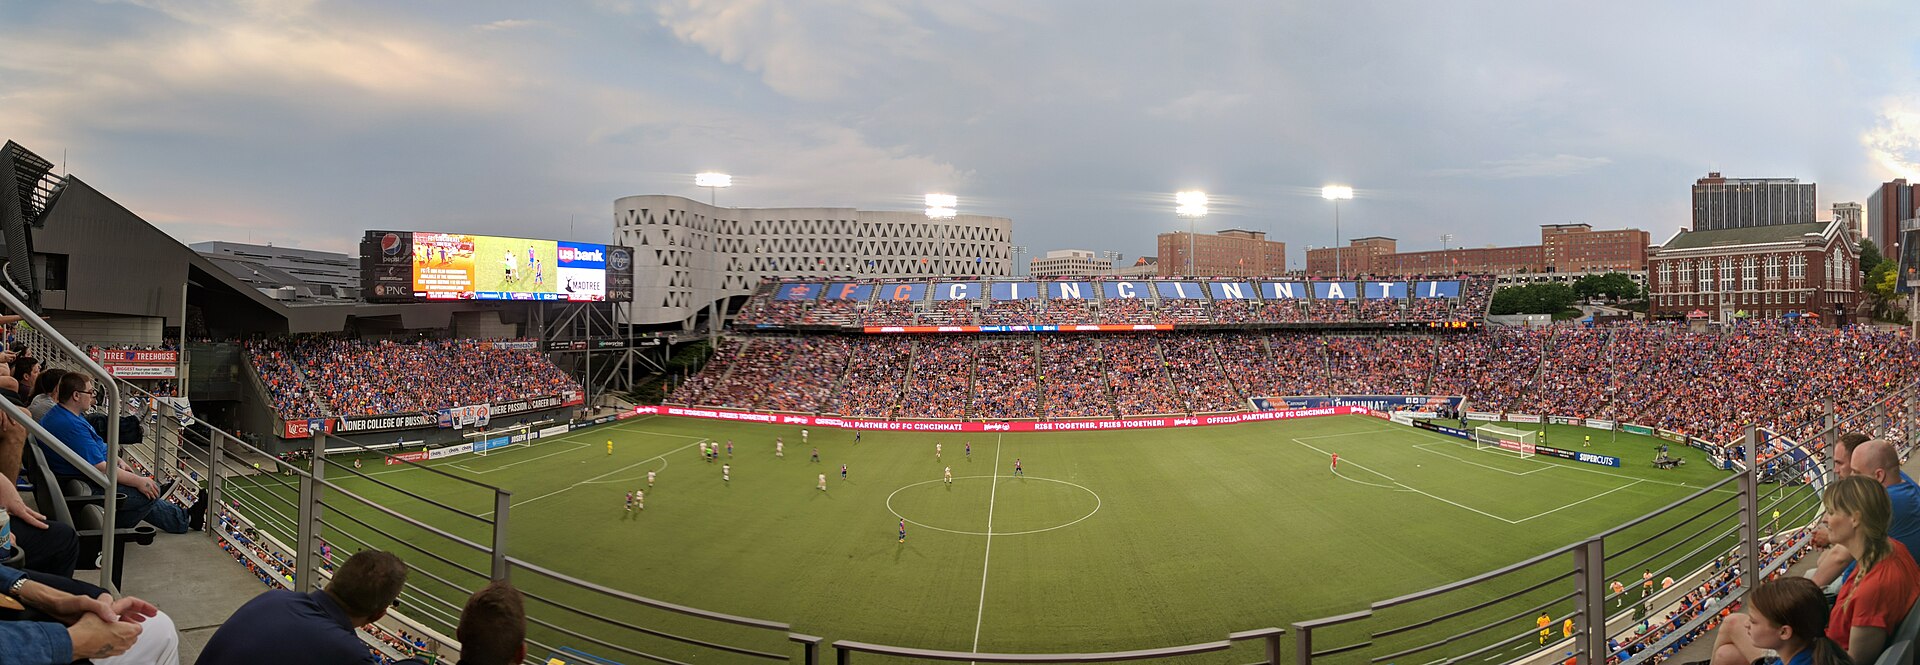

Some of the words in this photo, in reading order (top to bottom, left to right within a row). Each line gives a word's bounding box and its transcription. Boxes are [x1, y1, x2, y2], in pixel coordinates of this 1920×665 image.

[386, 286, 407, 295] PNC
[573, 281, 600, 291] MADTREE
[616, 290, 632, 299] PNC
[92, 352, 124, 361] MDTREE
[137, 352, 174, 361] TREEHOUSE
[490, 404, 508, 415] WHERE
[508, 402, 528, 413] PASSION
[533, 398, 550, 409] CAREER
[1336, 401, 1388, 411] CINCINNAT
[1206, 415, 1241, 424] OFFICIAL
[1243, 413, 1274, 421] PARTNER
[1296, 407, 1335, 417] CINCINNATI
[367, 418, 396, 430] COLLEGE
[396, 417, 405, 428] OF
[855, 421, 888, 429] PARTNER
[890, 422, 900, 430] OF
[902, 422, 912, 430] FC
[914, 422, 962, 431] CINCINNATI
[1099, 420, 1121, 428] FRIES
[1123, 419, 1165, 428] TOGETHER!
[1579, 453, 1613, 465] SUPERCUTS
